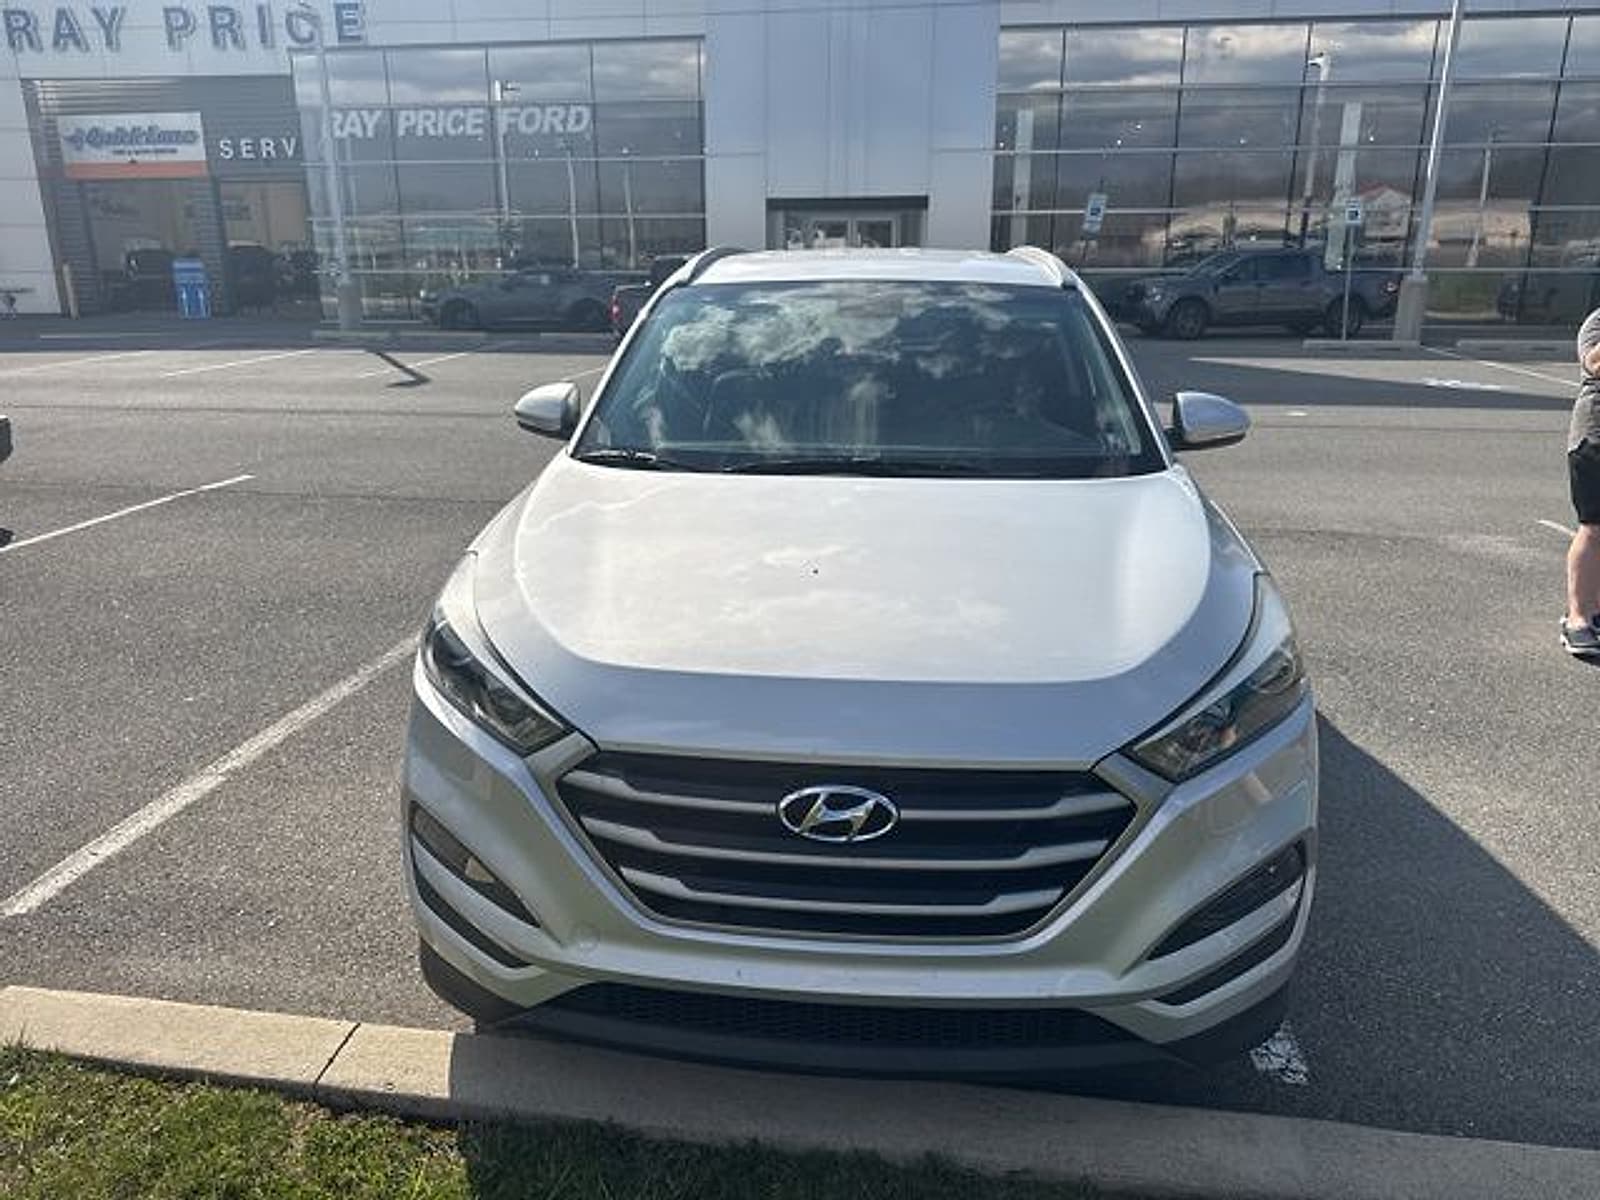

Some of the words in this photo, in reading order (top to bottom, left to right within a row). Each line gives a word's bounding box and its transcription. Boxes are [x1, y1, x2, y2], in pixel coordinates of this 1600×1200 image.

[3, 7, 122, 49] RAY
[163, 2, 363, 48] PRICE
[398, 107, 484, 137] PRICE
[497, 104, 591, 134] FORD
[219, 137, 297, 159] SERV
